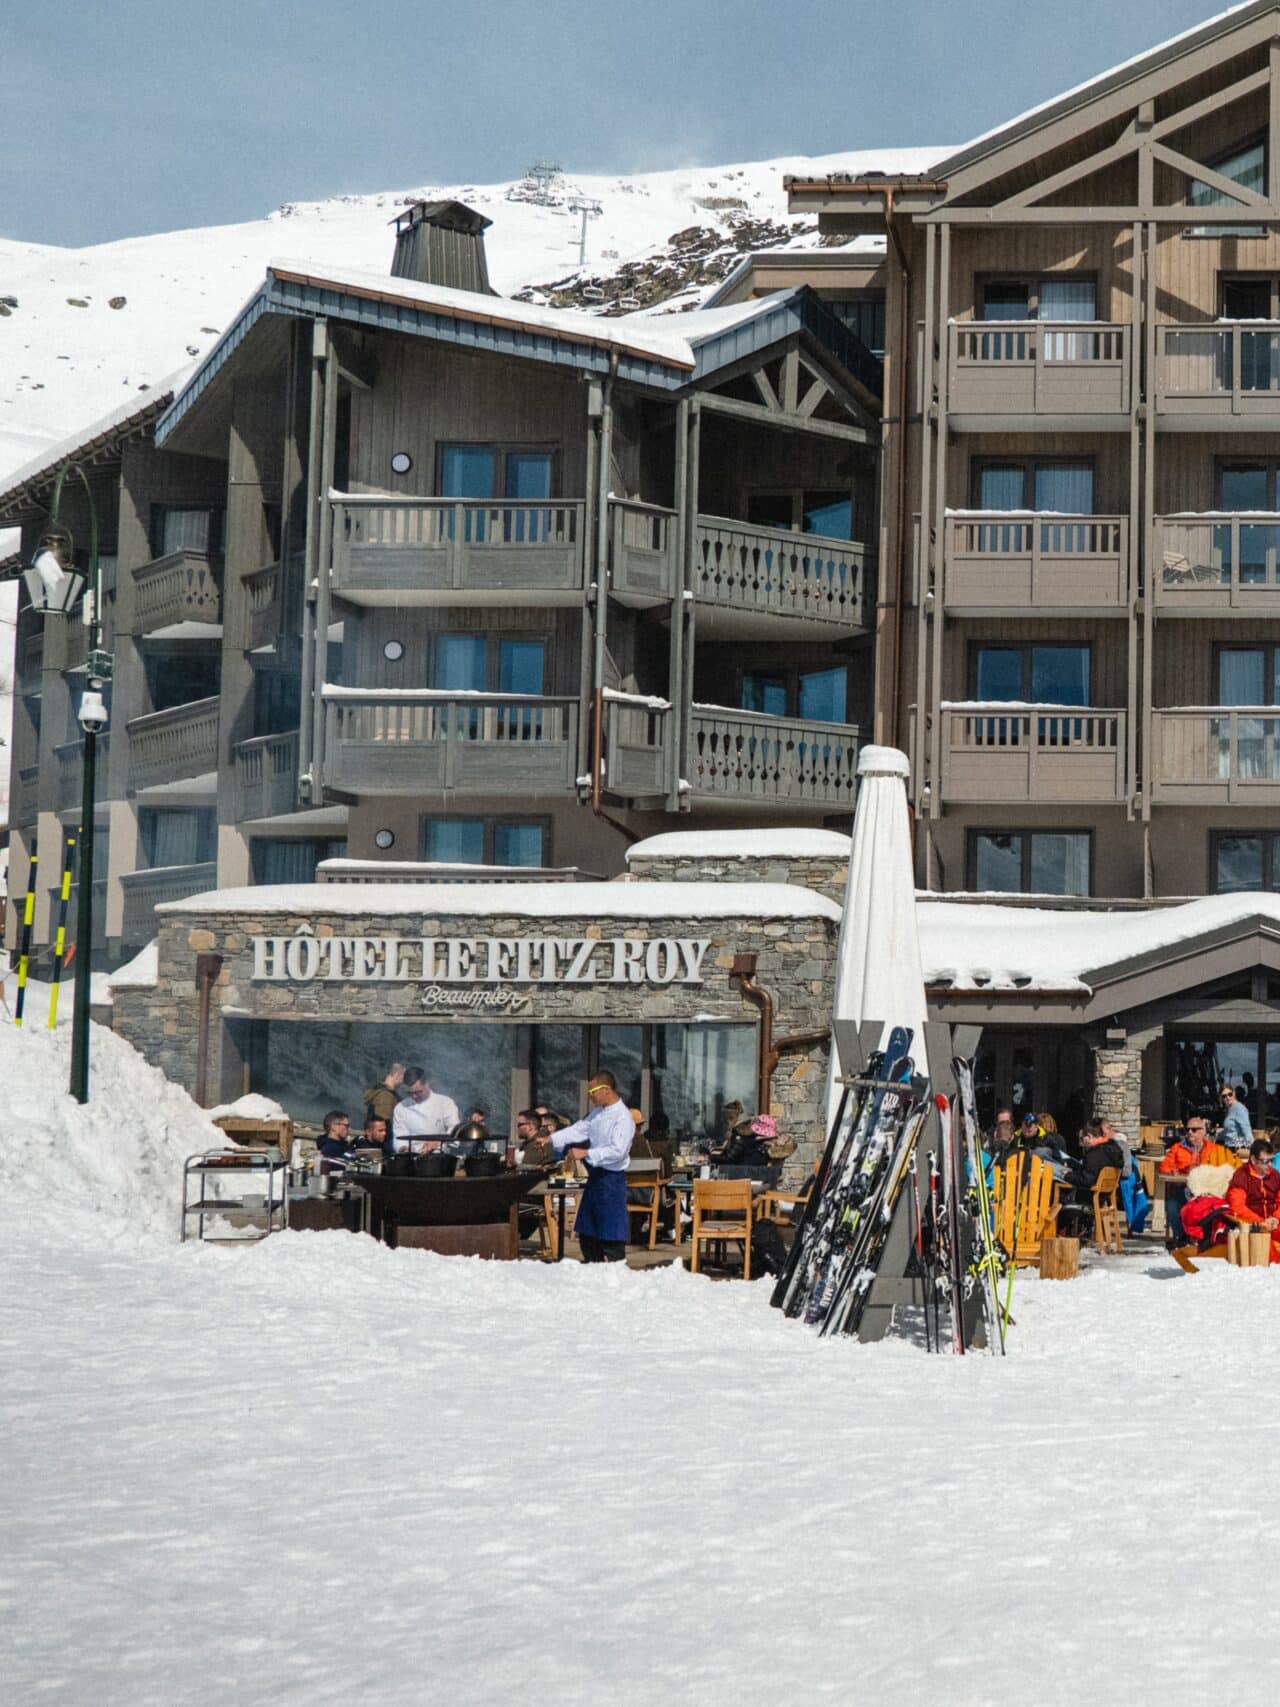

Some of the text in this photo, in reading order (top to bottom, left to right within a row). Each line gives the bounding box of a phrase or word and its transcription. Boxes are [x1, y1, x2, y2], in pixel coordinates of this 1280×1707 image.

[251, 923, 712, 984] HÔTEL LE FITZ ROY
[421, 985, 529, 1007] Beaumier
